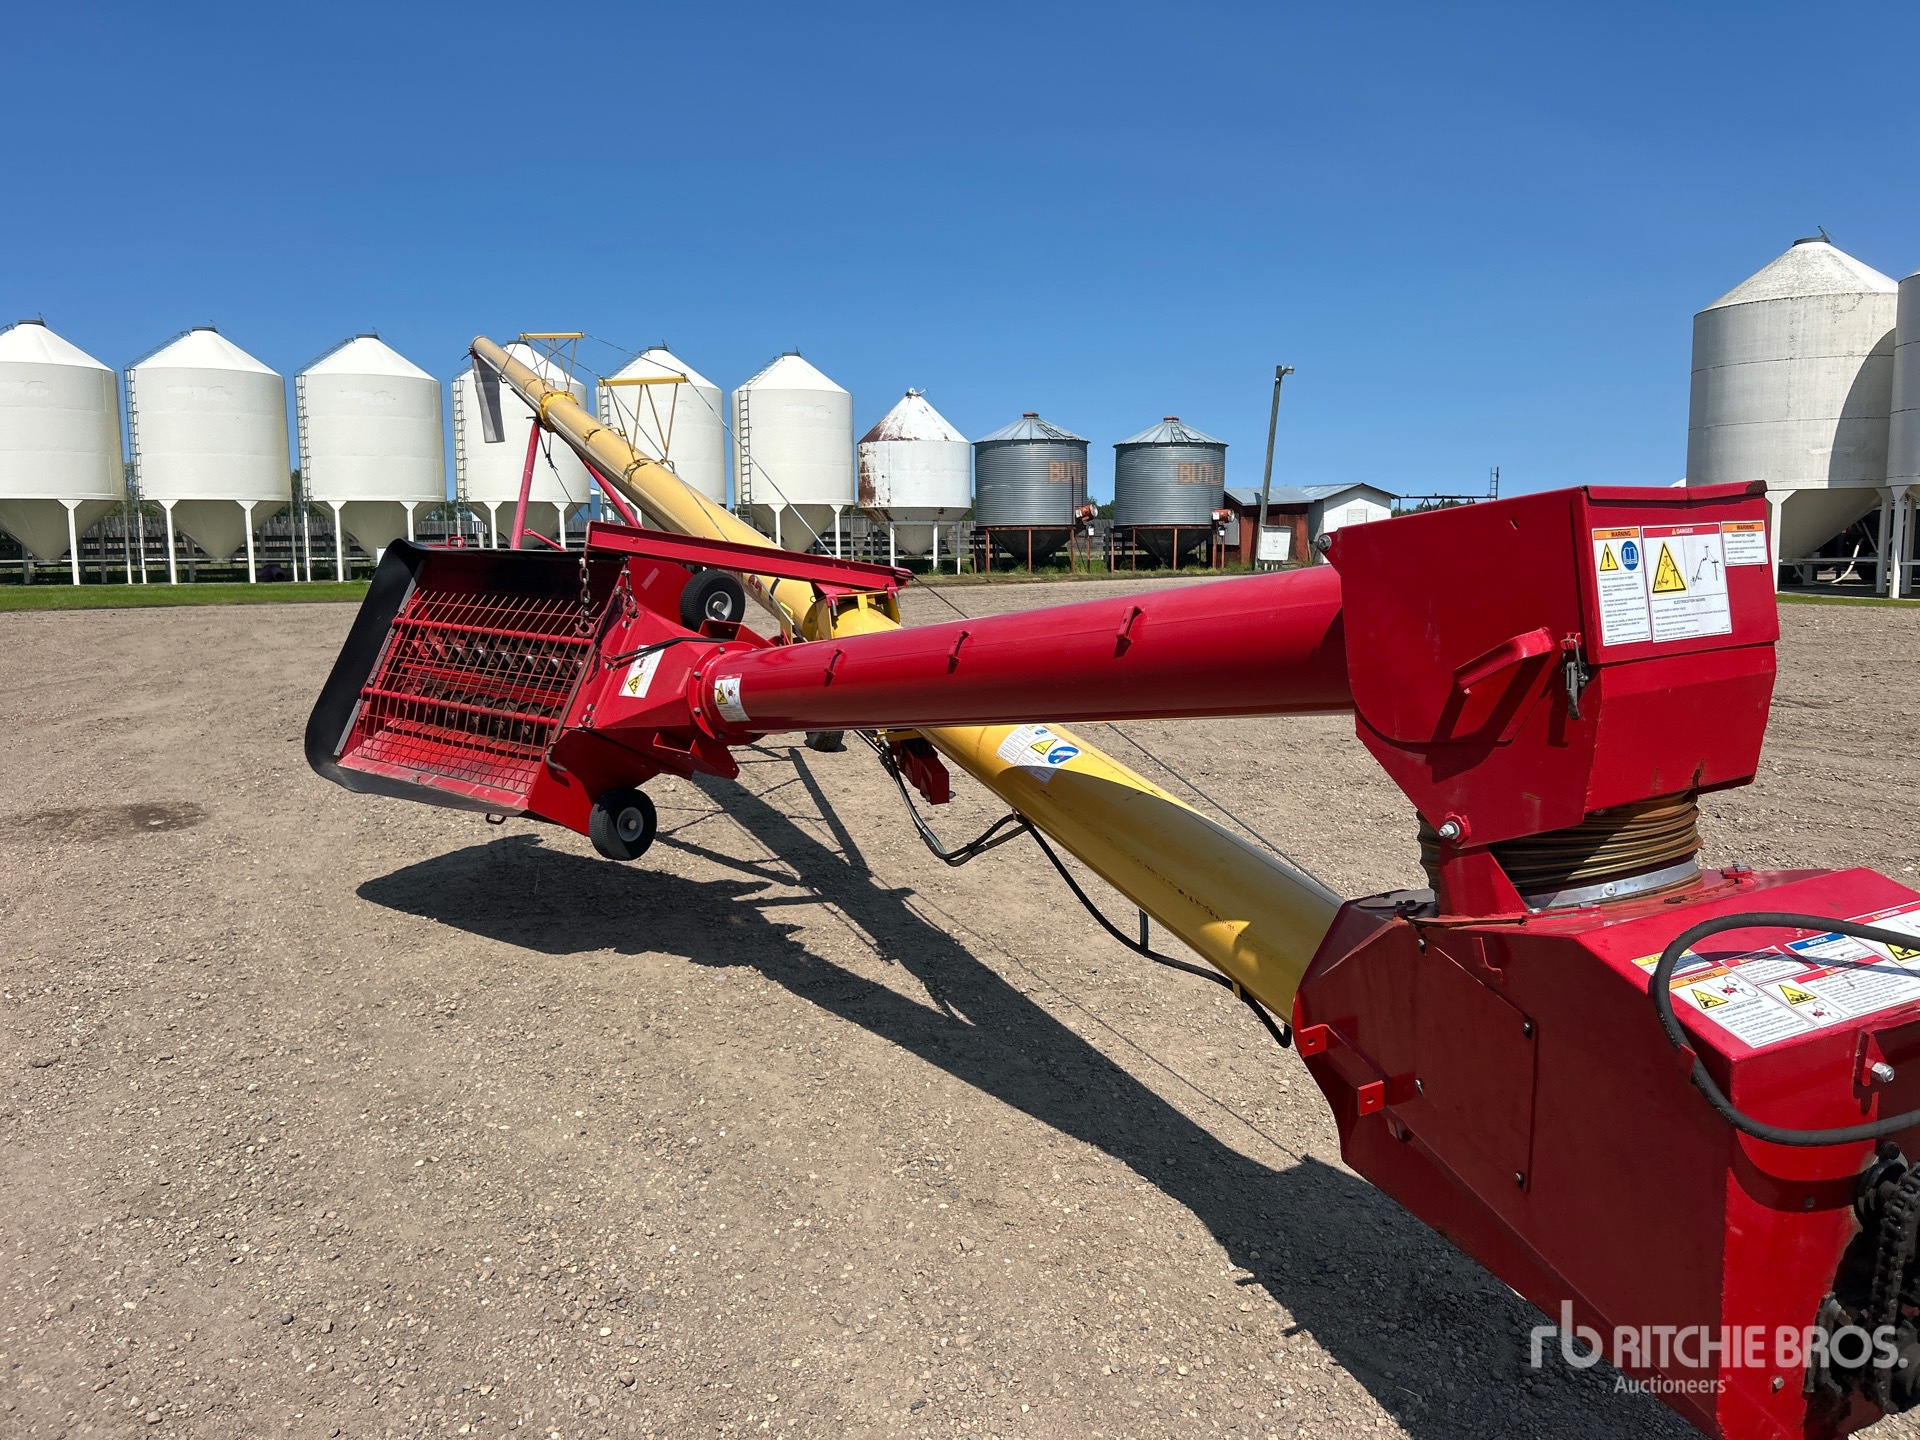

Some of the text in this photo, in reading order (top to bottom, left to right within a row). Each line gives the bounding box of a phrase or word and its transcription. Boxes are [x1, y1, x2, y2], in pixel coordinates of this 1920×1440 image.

[1676, 527, 1694, 535] DANGER
[1806, 936, 1829, 946] NOTICE
[1688, 972, 1716, 983] WARNING
